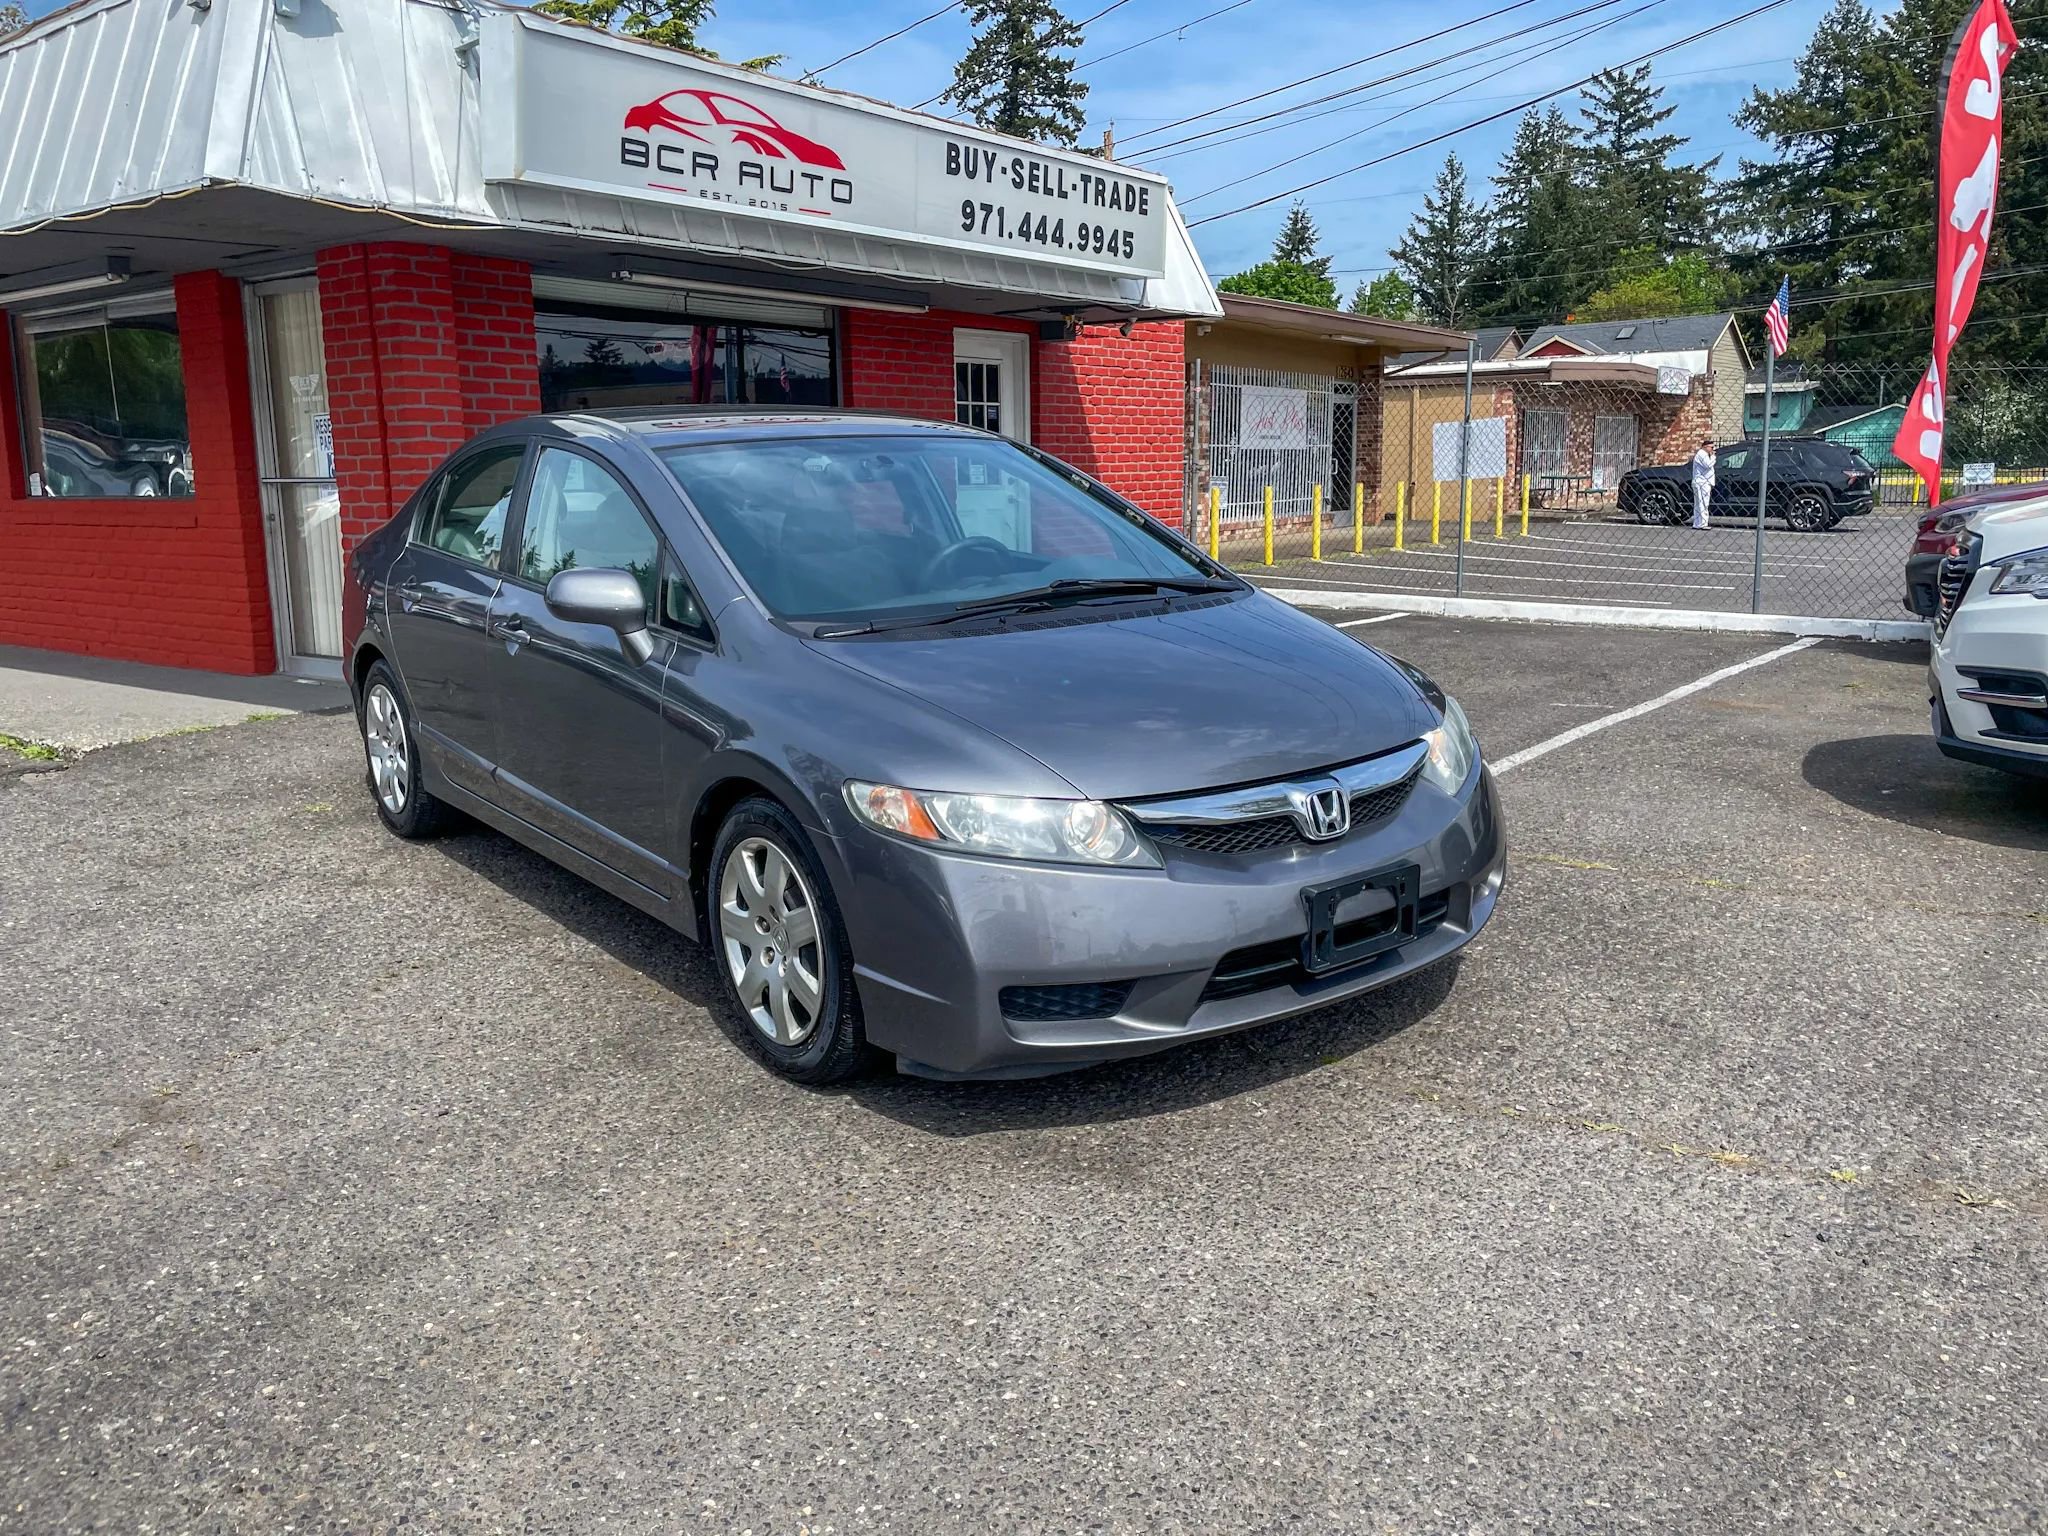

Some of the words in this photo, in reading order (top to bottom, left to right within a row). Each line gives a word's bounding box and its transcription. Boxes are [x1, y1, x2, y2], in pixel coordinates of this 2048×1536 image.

[620, 136, 719, 181] BCR
[738, 160, 853, 204] AUTO
[748, 198, 789, 211] 2015
[961, 199, 1134, 259] 971.444.9945
